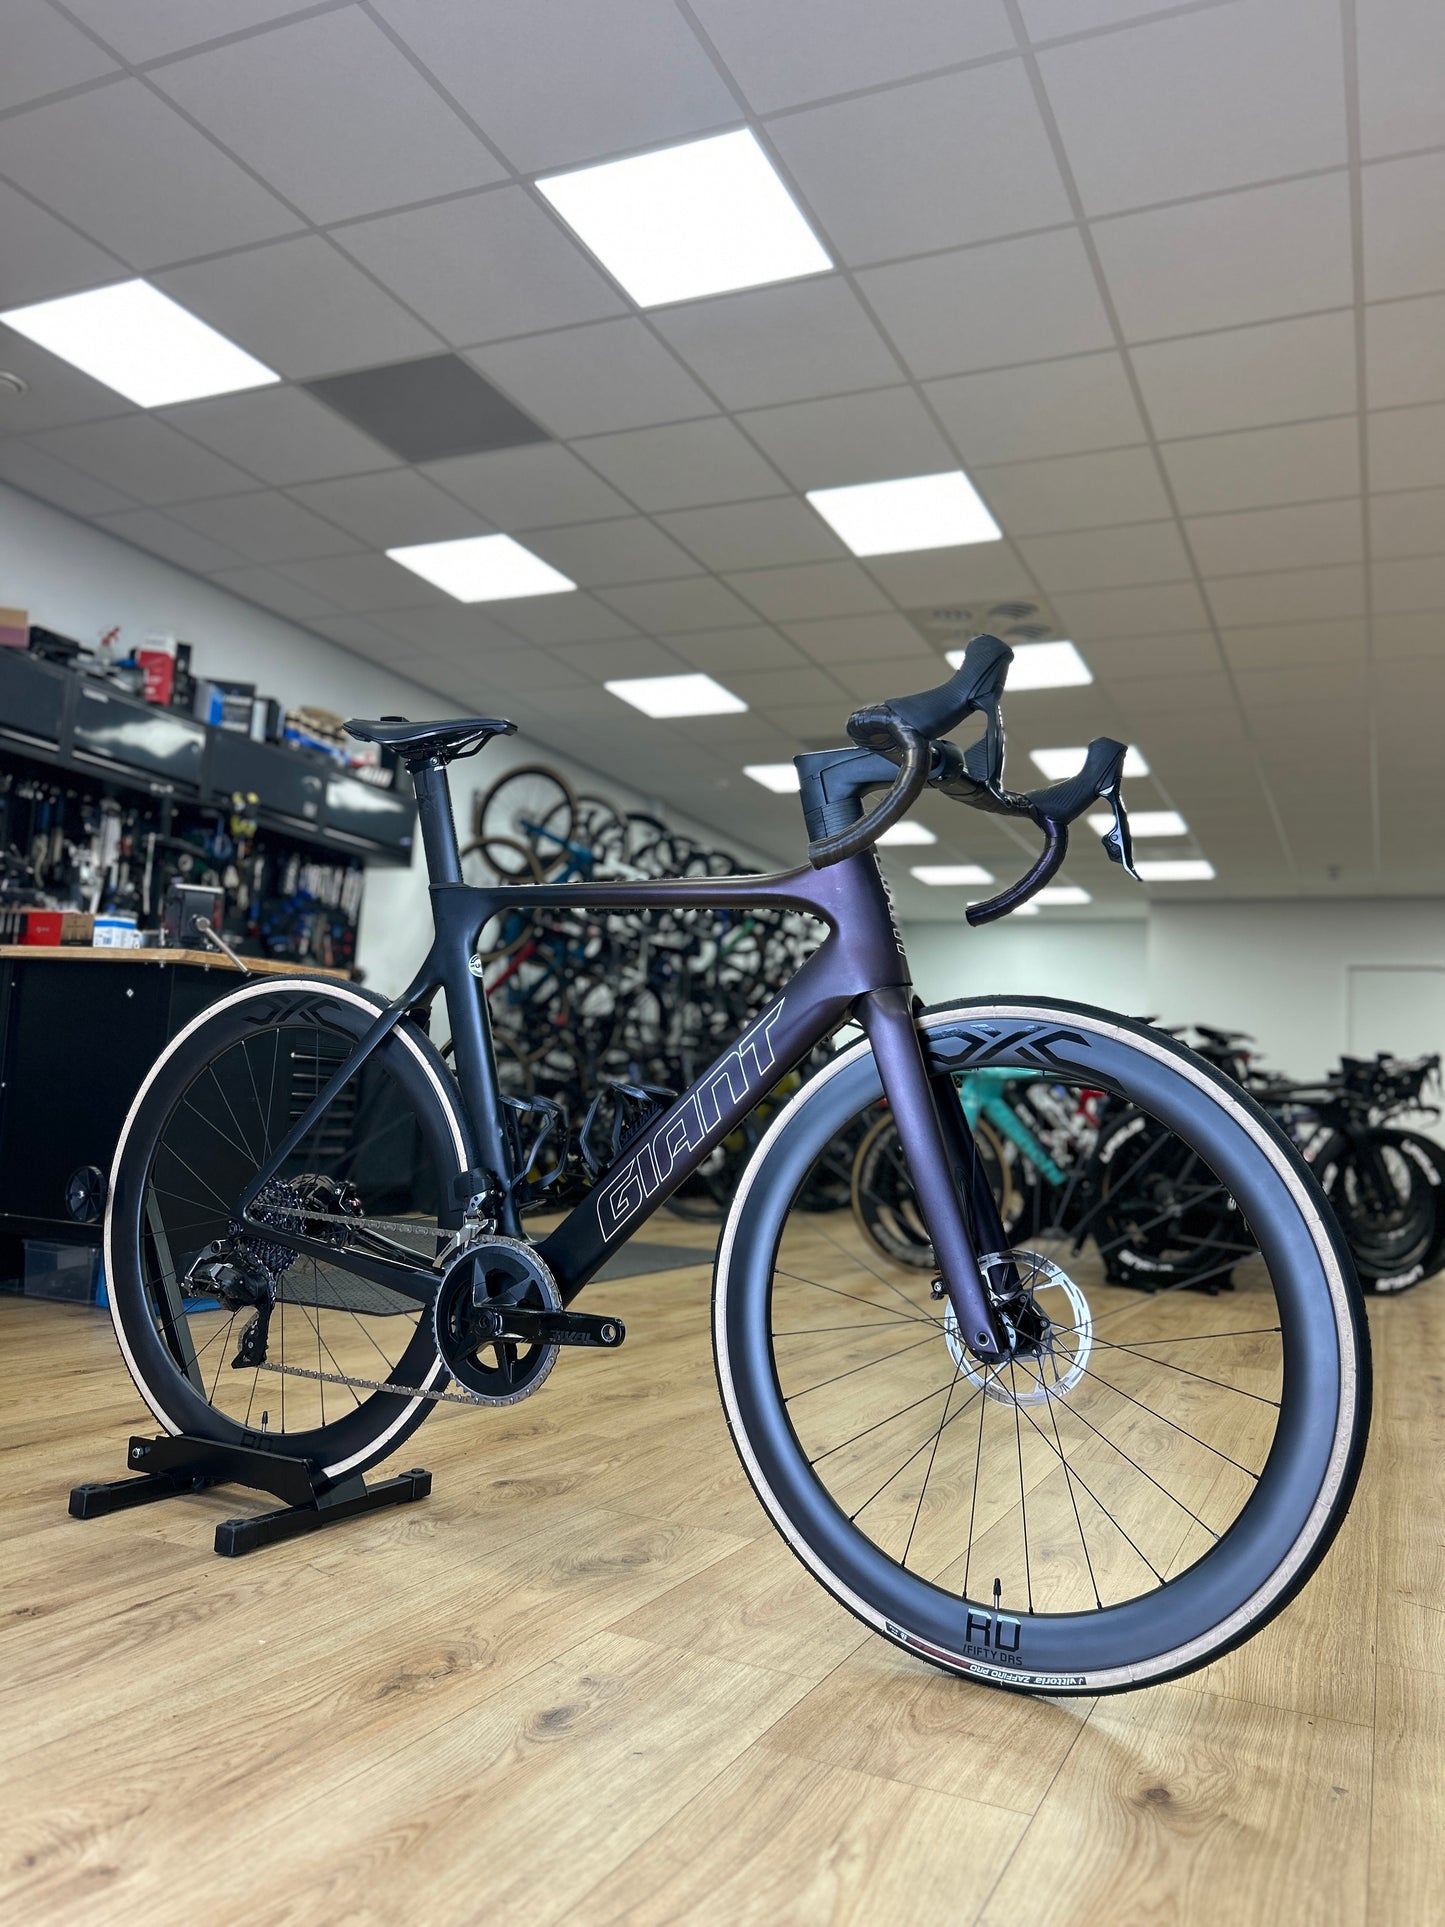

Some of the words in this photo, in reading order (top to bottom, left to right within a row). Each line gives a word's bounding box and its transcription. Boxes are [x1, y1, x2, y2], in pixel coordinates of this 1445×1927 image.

[597, 997, 785, 1243] GIANT
[969, 1665, 990, 1676] PRO
[992, 1670, 1031, 1684] ZAFFIRO
